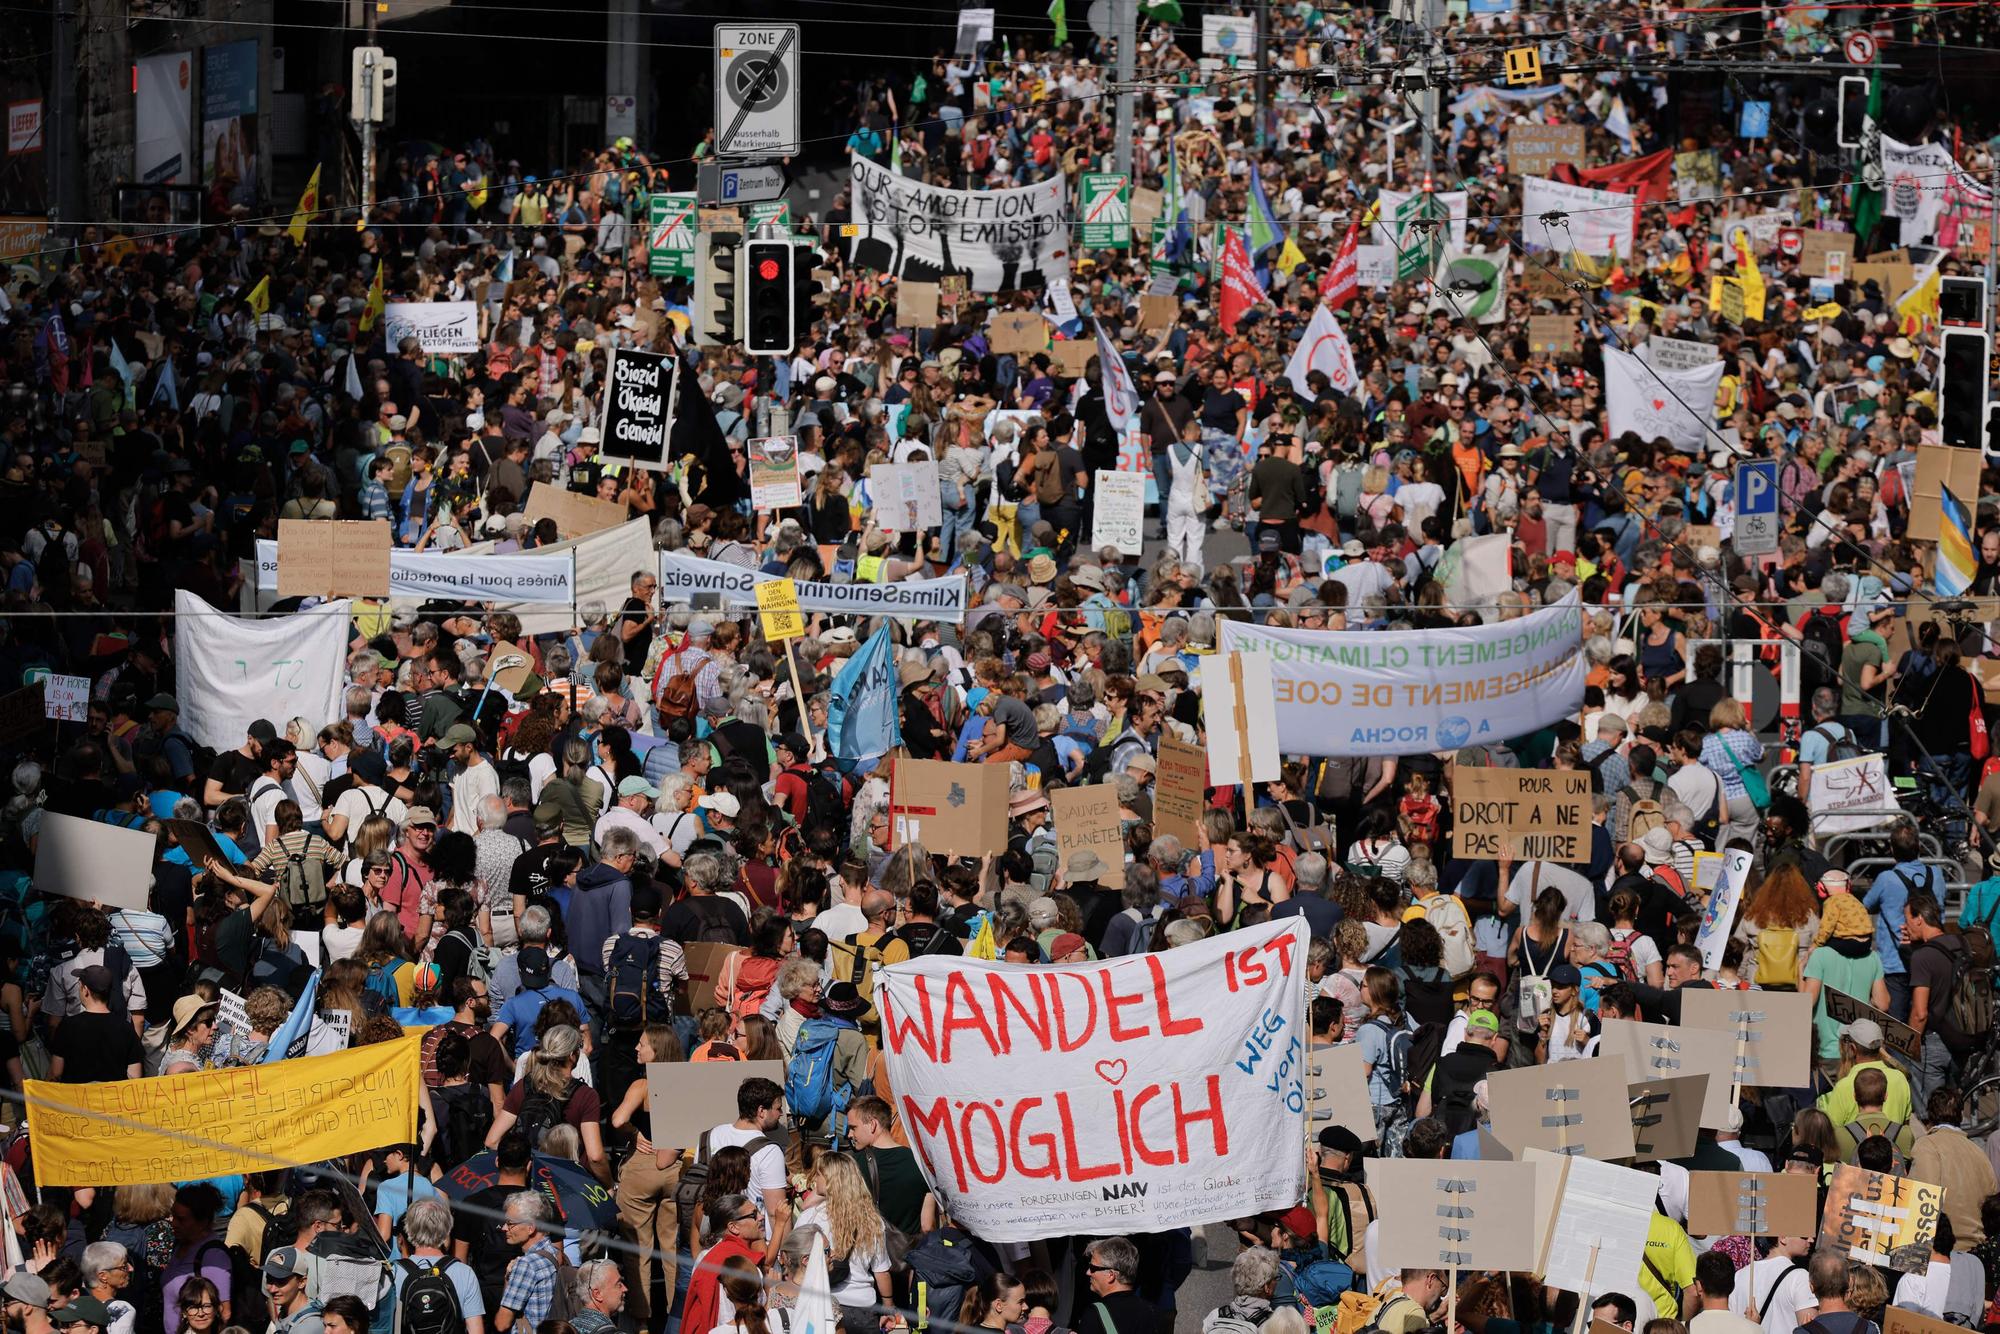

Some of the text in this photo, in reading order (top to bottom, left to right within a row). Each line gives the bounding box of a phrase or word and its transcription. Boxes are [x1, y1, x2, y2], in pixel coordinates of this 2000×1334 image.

[739, 32, 775, 45] ZONE
[733, 140, 782, 149] Markierung
[739, 179, 764, 190] Zentrum
[765, 175, 780, 188] Nord
[851, 160, 1036, 217] OUR AMBITION
[416, 328, 463, 339] FLIEGEN
[421, 338, 452, 347] RSTÖRT
[615, 359, 659, 388] Biozid
[618, 386, 661, 416] Ökozid
[616, 417, 663, 445] Genozid
[1747, 470, 1768, 510] P
[763, 581, 782, 590] STOPP
[760, 600, 798, 611] WAHNSINN
[52, 675, 89, 689] MY HOME
[53, 689, 73, 700] IS ON
[1519, 778, 1587, 794] POUR UN
[1061, 801, 1110, 820] SAUVEZ
[1459, 802, 1580, 826] DROIT A NE
[1062, 825, 1121, 849] PLANÈTE!
[1465, 832, 1577, 859] PAS NUIRE
[882, 932, 1298, 1064] WANDEL IST
[1235, 1006, 1287, 1076] WEG
[1267, 1034, 1301, 1095] VOM
[901, 1074, 1230, 1194] MÖGLICH
[1020, 1189, 1098, 1207] FORDERUNGEN
[1102, 1182, 1148, 1201] NAIV
[1157, 1180, 1173, 1195] ist
[1203, 1176, 1241, 1191] Glaube
[1094, 1200, 1145, 1218] BISHER!
